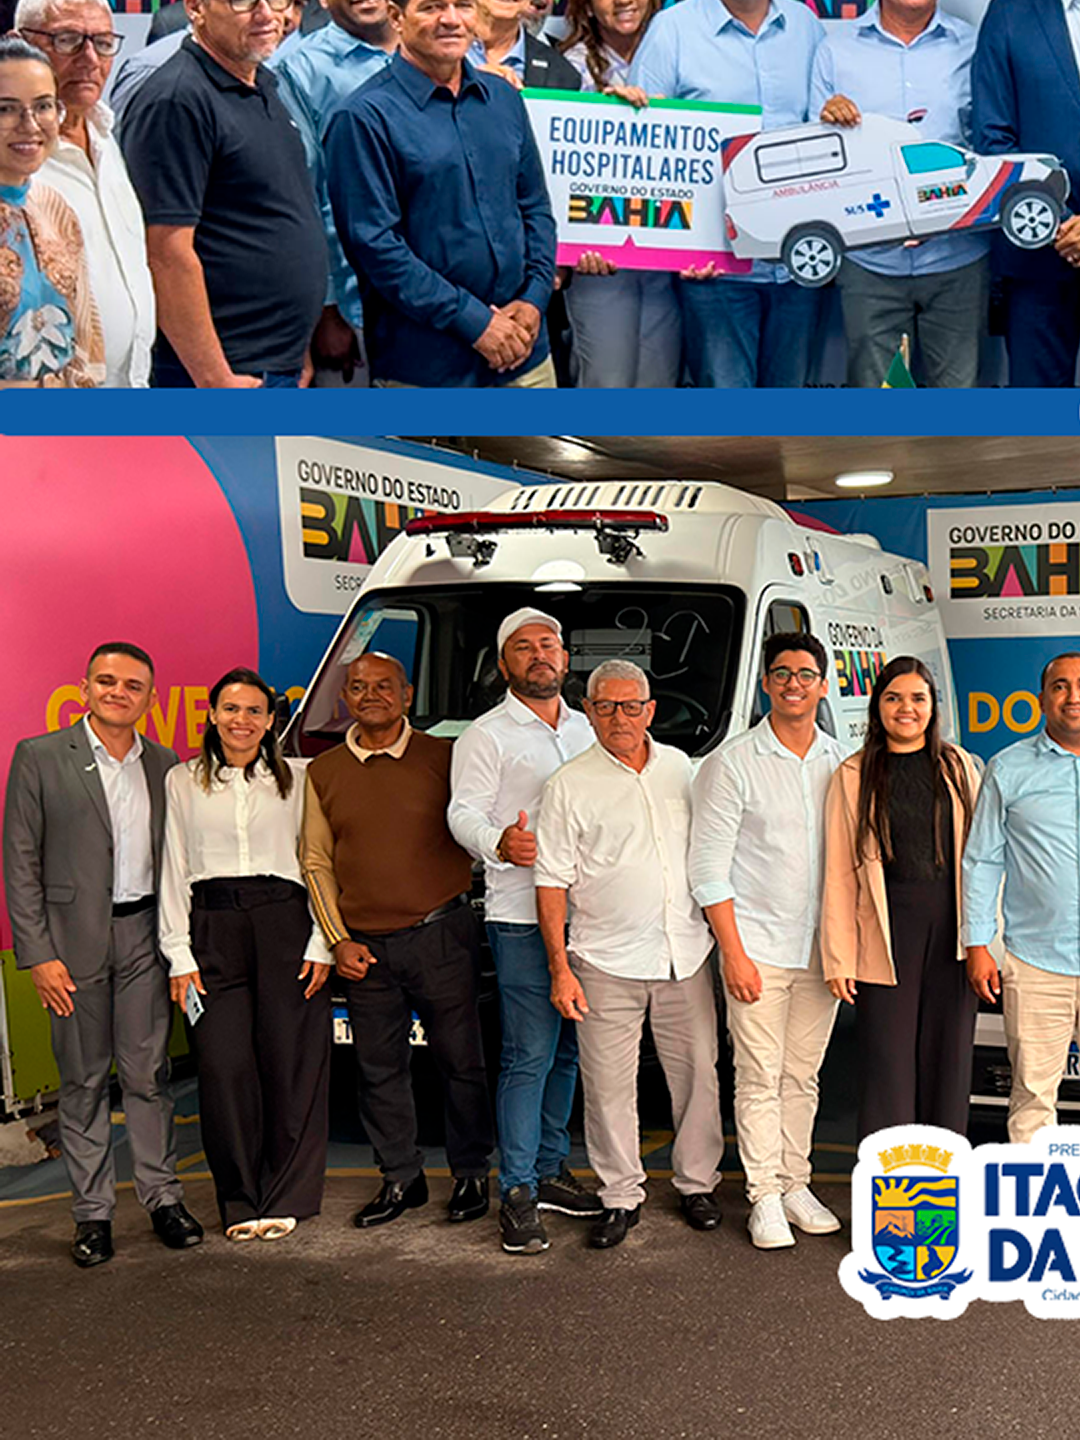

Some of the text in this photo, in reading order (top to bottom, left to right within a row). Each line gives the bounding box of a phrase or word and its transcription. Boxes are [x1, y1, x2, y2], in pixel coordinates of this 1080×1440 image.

[549, 116, 721, 152] EQUIPAMENTOS
[551, 150, 714, 185] HOSPITALARES
[569, 182, 694, 199] GOVERNO DO ESTADO
[298, 459, 461, 510] GOVERNO DO ESTADO
[949, 522, 1042, 544] GOVERNO
[1048, 520, 1076, 540] DO
[983, 605, 1056, 621] SECRETARIA
[1059, 604, 1077, 618] DA
[968, 690, 1042, 733] DO
